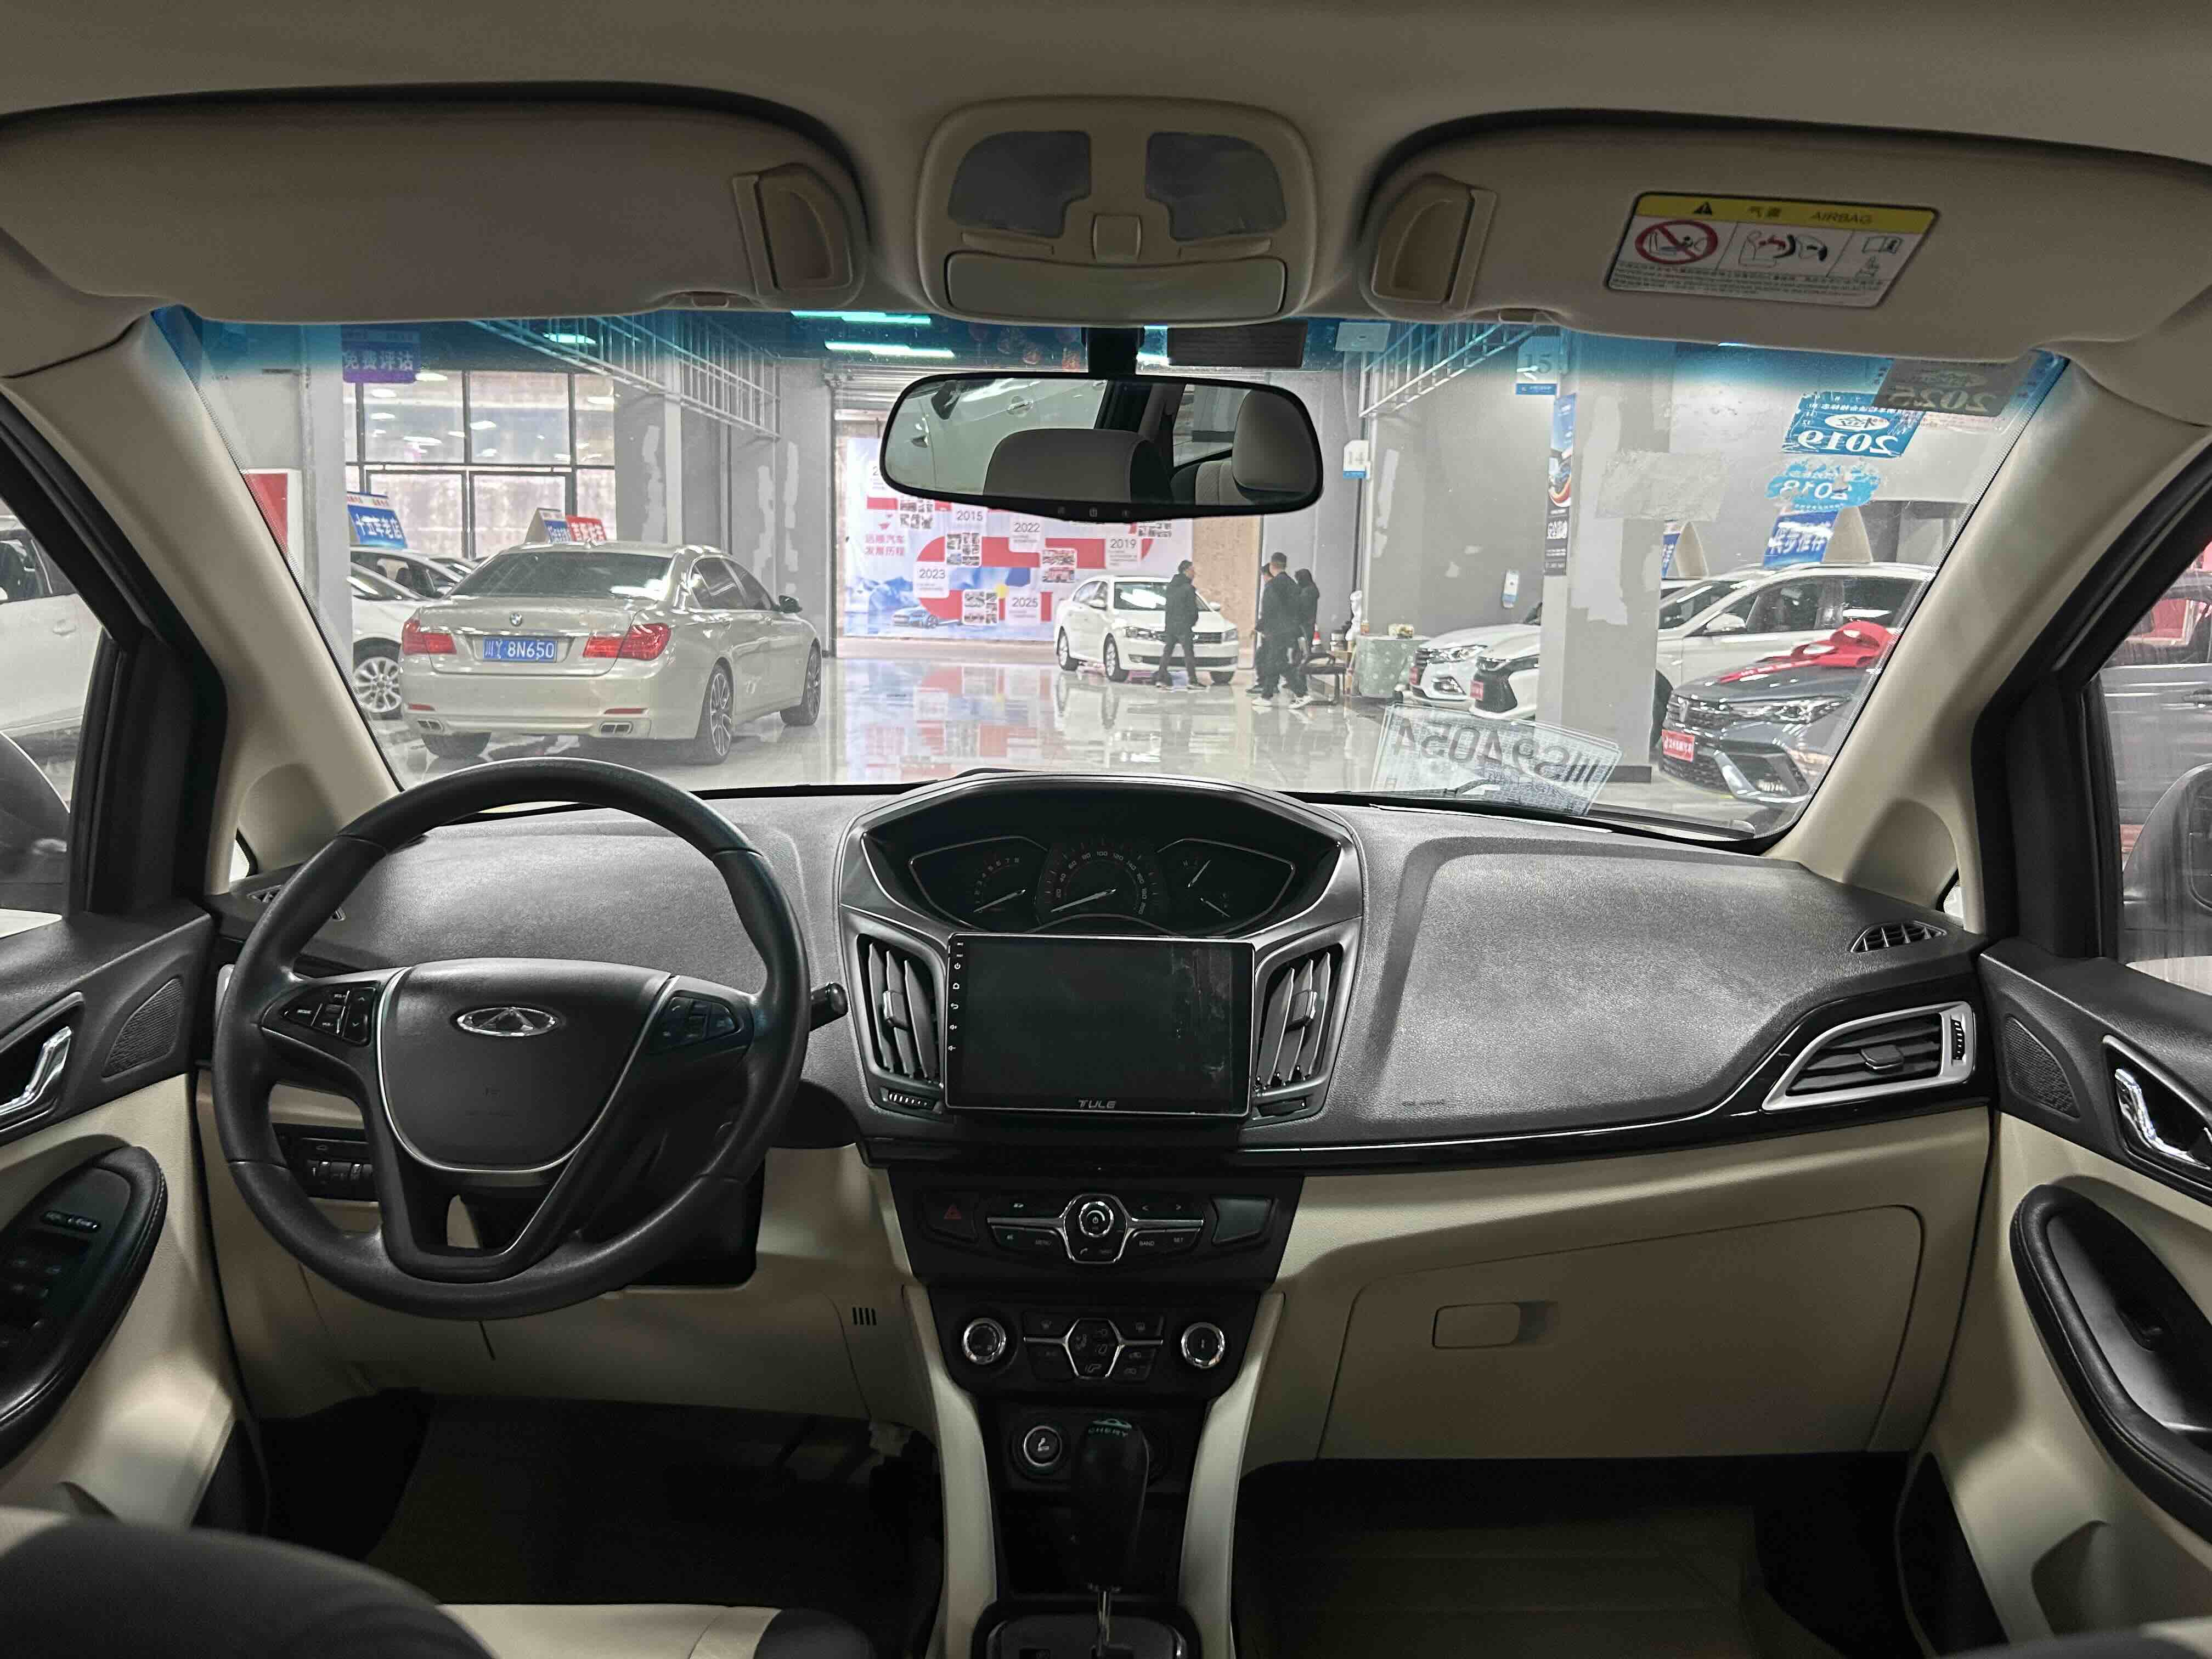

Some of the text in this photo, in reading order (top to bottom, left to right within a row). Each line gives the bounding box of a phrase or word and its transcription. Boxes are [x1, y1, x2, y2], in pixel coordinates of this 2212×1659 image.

[1811, 211, 1874, 224] AIRBAG
[343, 352, 413, 371] 免费评估
[956, 510, 984, 521] 2015
[1013, 522, 1041, 533] 2022
[1110, 539, 1137, 549] 2019
[919, 568, 945, 579] 2023
[1012, 597, 1039, 607] 2025
